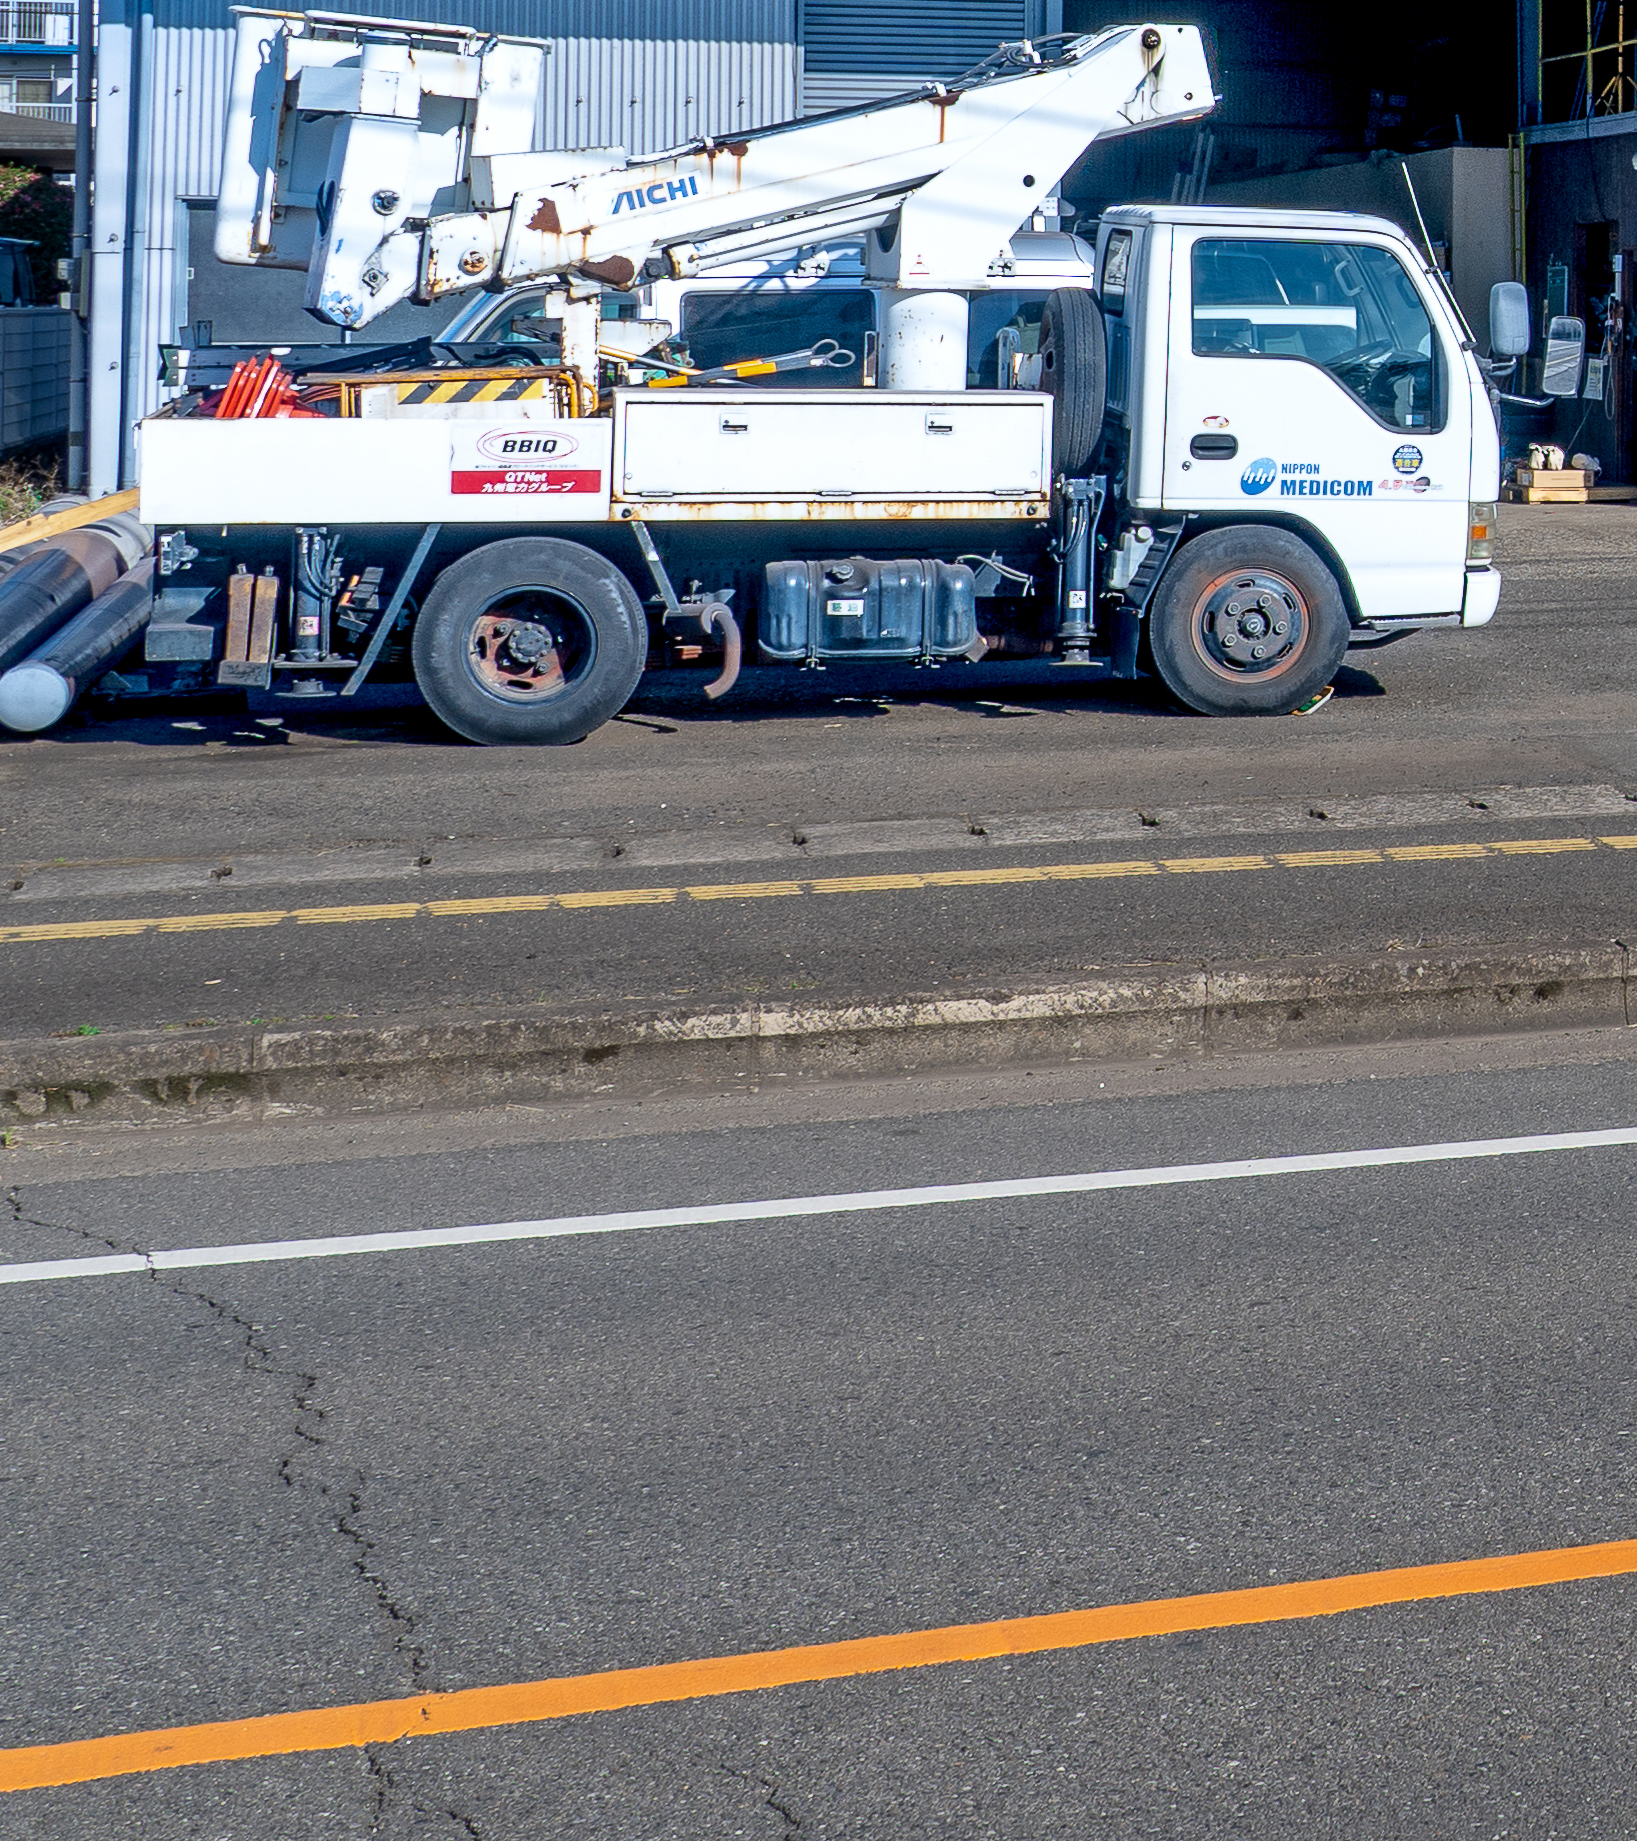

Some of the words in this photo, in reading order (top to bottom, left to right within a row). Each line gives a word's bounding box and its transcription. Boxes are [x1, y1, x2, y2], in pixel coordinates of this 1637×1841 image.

[612, 176, 698, 215] AICHI
[502, 439, 558, 454] BBIQ
[1281, 463, 1320, 475] NIPPON
[1280, 479, 1374, 497] MEDICOM
